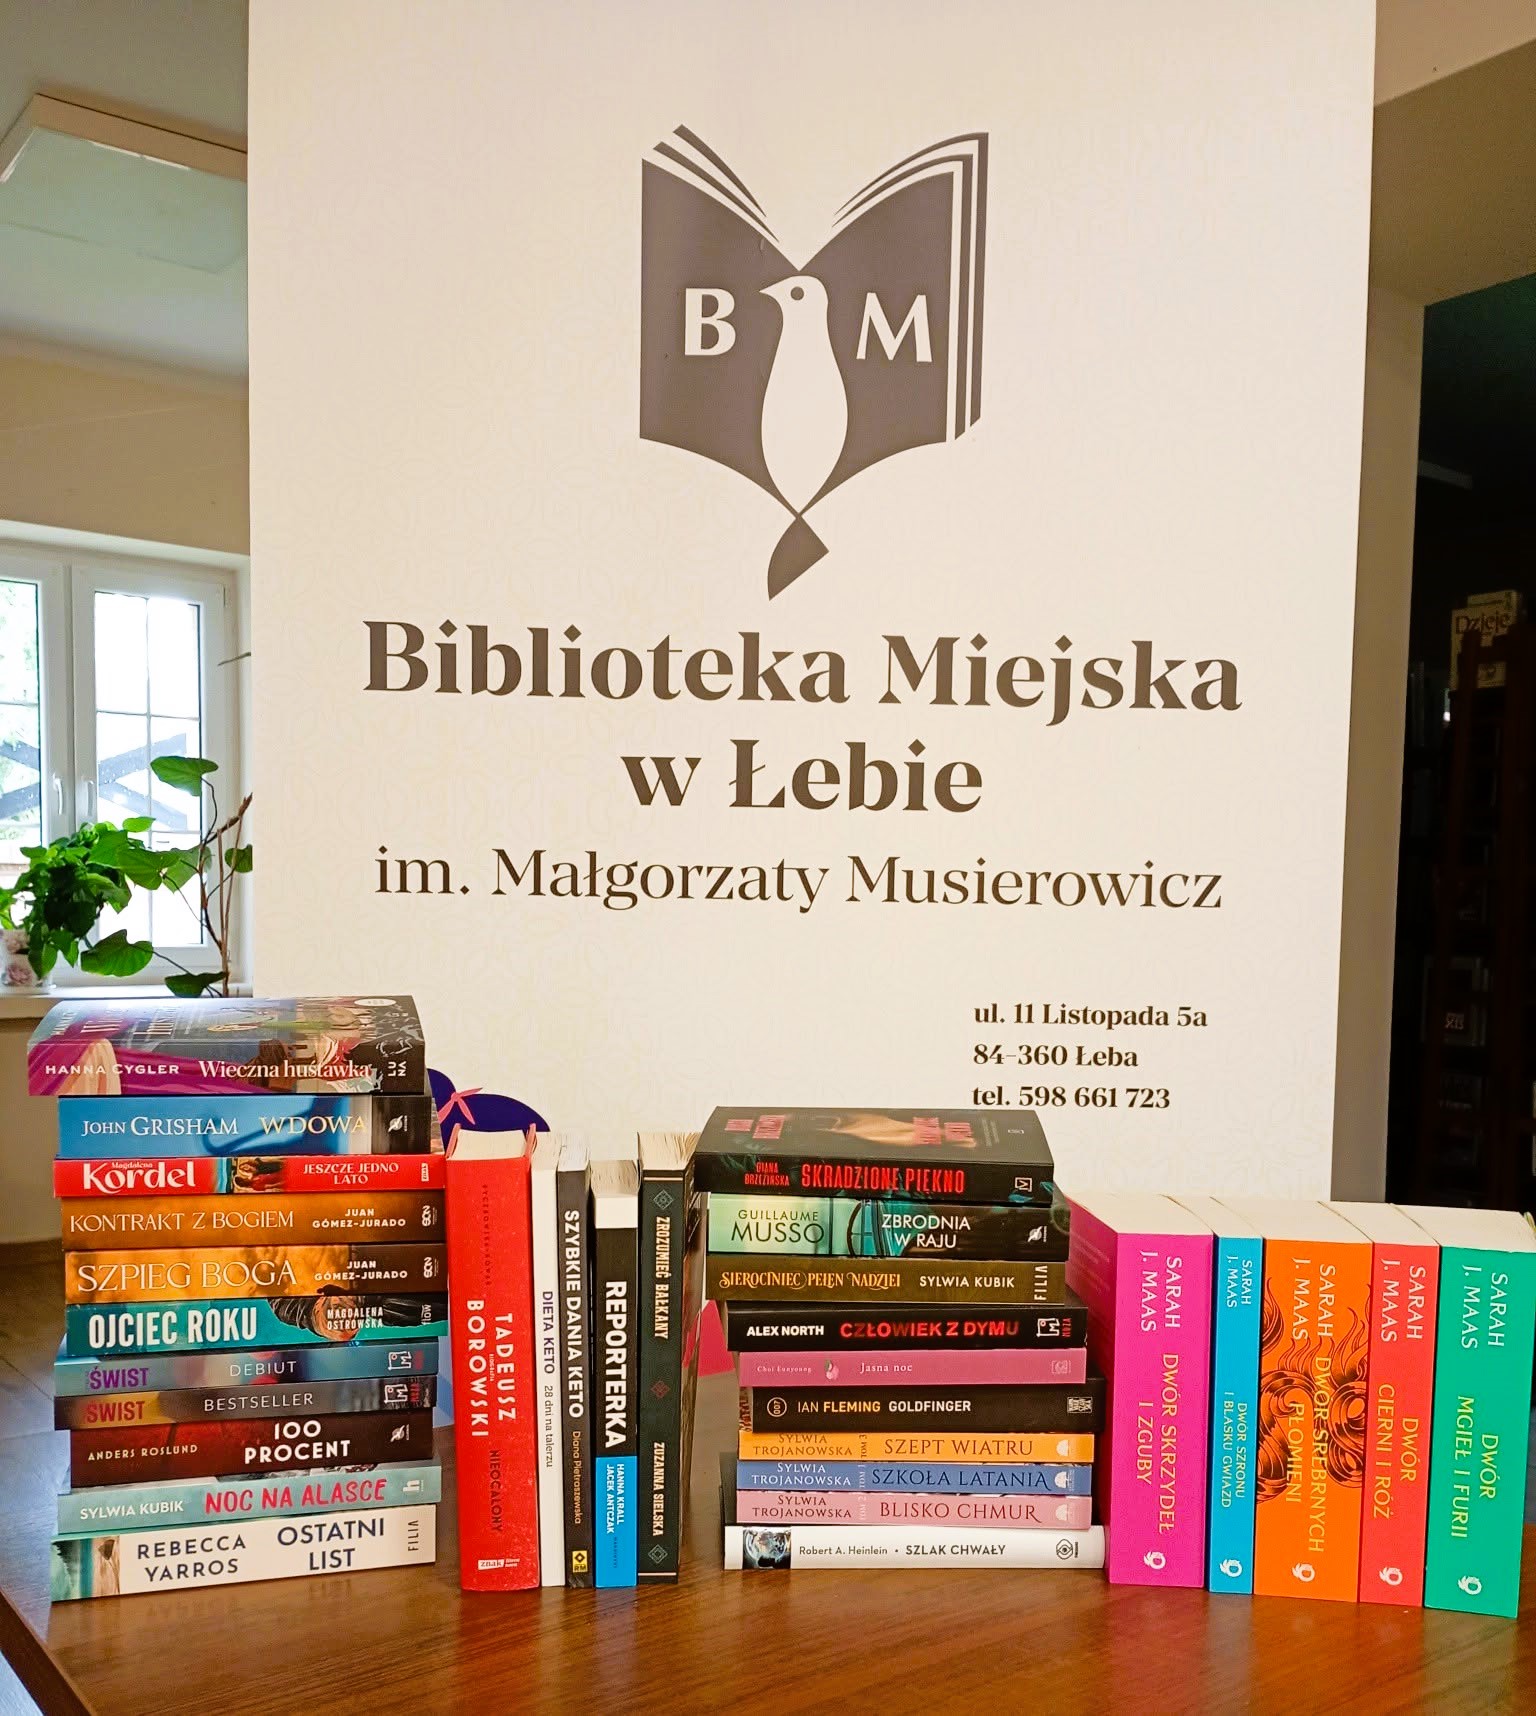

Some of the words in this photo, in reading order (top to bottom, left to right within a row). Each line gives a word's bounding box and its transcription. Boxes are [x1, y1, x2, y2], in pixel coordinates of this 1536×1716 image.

[684, 287, 737, 356] B
[856, 292, 932, 363] M
[363, 620, 849, 704] Biblioteka
[879, 634, 1242, 726] Miejska
[620, 753, 702, 807] w
[729, 739, 982, 813] Łebie
[374, 846, 470, 895] im.
[492, 848, 831, 914] Małgorzaty
[847, 854, 1223, 909] Musierowicz
[974, 1003, 1005, 1024] ul.
[1013, 1003, 1035, 1024] 11
[1042, 1003, 1170, 1030] Listopada
[1176, 1006, 1208, 1027] 5a
[45, 1064, 106, 1075] HANNA
[112, 1064, 179, 1075] CYGLER
[199, 1059, 280, 1079] Wieczna
[284, 1059, 371, 1080] huśtawka
[1075, 1045, 1139, 1067] Łeba
[971, 1085, 1010, 1106] tel.
[1018, 1085, 1067, 1107] 598
[1074, 1087, 1118, 1108] 661
[1125, 1088, 1170, 1109] 723
[82, 1119, 126, 1136] JOHN
[130, 1115, 238, 1136] GRISHAM
[259, 1116, 367, 1135] WDOWA
[83, 1161, 196, 1194] Kordel
[303, 1163, 356, 1175] JESZCZE
[358, 1162, 399, 1174] JEDNO
[334, 1174, 369, 1185] LATO
[757, 1162, 779, 1174] DIANA
[801, 1163, 899, 1191] SKRADZIONE
[905, 1168, 965, 1194] PIĘKNO
[70, 1212, 186, 1233] KONTRAKT
[192, 1213, 206, 1229] Z
[213, 1209, 294, 1230] BOGIEM
[312, 1216, 406, 1229] GÓMEZ-JURADO
[345, 1208, 375, 1217] JUAN
[738, 1209, 819, 1221] GUILLAUME
[882, 1213, 971, 1231] ZBRODNIA
[655, 1216, 671, 1279] ZROZUMIEĆ
[731, 1222, 825, 1244] MUSSO
[894, 1233, 914, 1248] W
[917, 1234, 957, 1249] RAJU
[346, 1260, 377, 1270] JUAN
[564, 1210, 581, 1292] SZYBKIE
[78, 1262, 191, 1293] SZPIEG
[201, 1258, 298, 1289] BOGA
[314, 1268, 408, 1281] GÓMEZ-JURADO
[719, 1271, 806, 1290] SIEROCINIEC
[846, 1271, 901, 1291] NADZIEI
[919, 1276, 969, 1288] SYLWIA
[974, 1276, 1015, 1288] KUBIK
[1034, 1265, 1048, 1301] FILIA
[1226, 1268, 1238, 1308] MAAS
[1240, 1259, 1253, 1305] SARAH
[1140, 1270, 1157, 1332] MAAS
[1165, 1257, 1182, 1329] SARAH
[1317, 1264, 1336, 1338] SARAH
[1406, 1265, 1426, 1340] SARAH
[327, 1306, 384, 1320] MAGDALENA
[327, 1316, 384, 1330] OSTROWSKA
[542, 1291, 554, 1332] DIETA
[654, 1283, 669, 1340] BAŁKANY
[1292, 1278, 1310, 1341] MAAS
[1380, 1279, 1400, 1342] MAAS
[1461, 1285, 1481, 1349] MAAS
[1488, 1272, 1509, 1348] SARAH
[88, 1311, 178, 1349] OJCIEC
[187, 1307, 257, 1343] ROKU
[566, 1297, 582, 1361] DANIA
[746, 1325, 779, 1337] ALEX
[781, 1324, 824, 1337] NORTH
[840, 1322, 942, 1338] CZŁOWIEK
[946, 1322, 959, 1337] Z
[963, 1320, 1020, 1337] DYMU
[229, 1360, 297, 1377] DEBIUT
[466, 1300, 489, 1437] BOROWSKI
[495, 1313, 516, 1421] TADEUSZ
[543, 1337, 555, 1374] KETO
[605, 1281, 627, 1449] REPORTERKA
[860, 1361, 889, 1374] Jasna
[893, 1362, 913, 1373] noc
[89, 1366, 149, 1390] ŚWIST
[544, 1386, 554, 1398] 28
[568, 1366, 584, 1418] KETO
[1161, 1354, 1179, 1416] DWÓR
[1313, 1357, 1333, 1421] DWÓR
[204, 1393, 314, 1412] BESTSELLER
[544, 1400, 554, 1416] dni
[798, 1401, 819, 1413] IAN
[823, 1401, 881, 1413] FLEMING
[888, 1400, 971, 1413] GOLDFINGER
[274, 1420, 321, 1440] 100
[1223, 1401, 1234, 1453] BLASKU
[1237, 1402, 1247, 1441] DWÓR
[1375, 1384, 1395, 1455] CIERNI
[1452, 1396, 1474, 1461] MGIEŁ
[88, 1449, 135, 1461] ANDERS
[141, 1444, 198, 1457] ROSLUND
[244, 1440, 351, 1465] PROCENT
[545, 1433, 554, 1468] talerzu
[572, 1431, 581, 1460] Diana
[753, 1446, 853, 1458] TROJANOWSKA
[778, 1433, 827, 1444] SYLWIA
[884, 1438, 944, 1455] SZEPT
[952, 1439, 1034, 1456] WIATRU
[1136, 1415, 1154, 1485] ZGUBY
[1285, 1403, 1305, 1503] PŁOMIENI
[1399, 1417, 1419, 1482] DWÓR
[606, 1464, 615, 1492] JACEK
[616, 1463, 625, 1491] HANNA
[653, 1442, 665, 1491] ZUZANNA
[752, 1475, 852, 1487] TROJANOWSKA
[777, 1462, 826, 1474] SYLWIA
[872, 1468, 948, 1486] SZKOŁA
[959, 1470, 1051, 1491] LATANIA
[1158, 1423, 1177, 1534] SKRZYDEŁ
[1235, 1445, 1247, 1498] SZRONU
[1478, 1434, 1499, 1500] DWÓR
[205, 1491, 253, 1514] NOC
[262, 1487, 290, 1509] NA
[302, 1479, 387, 1506] ALASCE
[573, 1462, 583, 1525] Pietraszewska
[1221, 1457, 1233, 1508] GWIAZD
[1309, 1426, 1330, 1553] SREBRNYCH
[1373, 1475, 1393, 1519] RÓŻ
[80, 1502, 136, 1520] SYLWIA
[139, 1500, 184, 1516] KUBIK
[606, 1493, 615, 1534] ANTCZAK
[616, 1493, 625, 1525] KRALL
[652, 1493, 664, 1537] SIELSKA
[752, 1507, 852, 1519] TROJANOWSKA
[778, 1495, 827, 1506] SYLWIA
[880, 1502, 950, 1519] BLISKO
[957, 1503, 1043, 1523] CHMUR
[1451, 1481, 1470, 1538] FURII
[138, 1534, 247, 1560] REBECCA
[277, 1517, 385, 1547] OSTATNI
[408, 1519, 420, 1552] FILIA
[309, 1548, 356, 1571] LIST
[799, 1546, 832, 1556] Robert
[835, 1546, 845, 1556] A.
[848, 1546, 888, 1556] Heinlein
[905, 1545, 947, 1556] SZLAK
[950, 1544, 1006, 1556] CHWAŁY
[145, 1558, 239, 1583] YARROS
